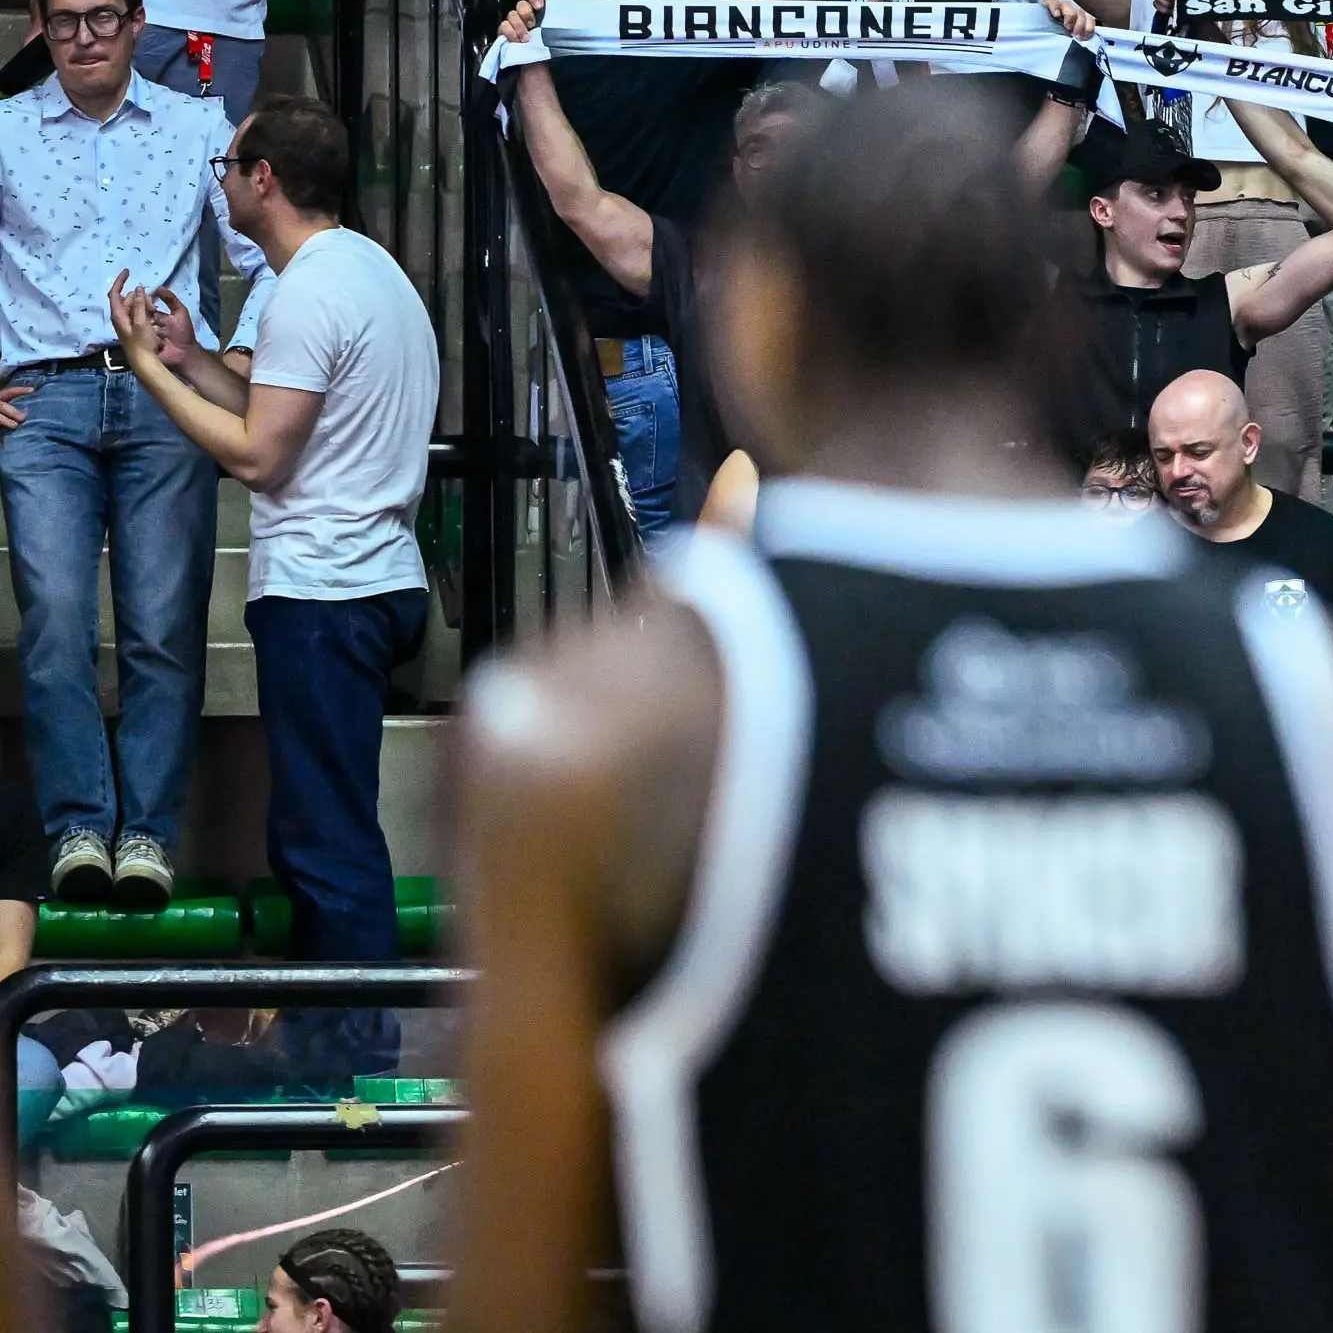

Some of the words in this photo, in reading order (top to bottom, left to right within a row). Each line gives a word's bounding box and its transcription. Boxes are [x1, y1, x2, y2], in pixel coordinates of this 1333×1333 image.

[620, 4, 1000, 41] BIANCONERI
[762, 39, 796, 49] APU
[800, 39, 852, 49] UDINE
